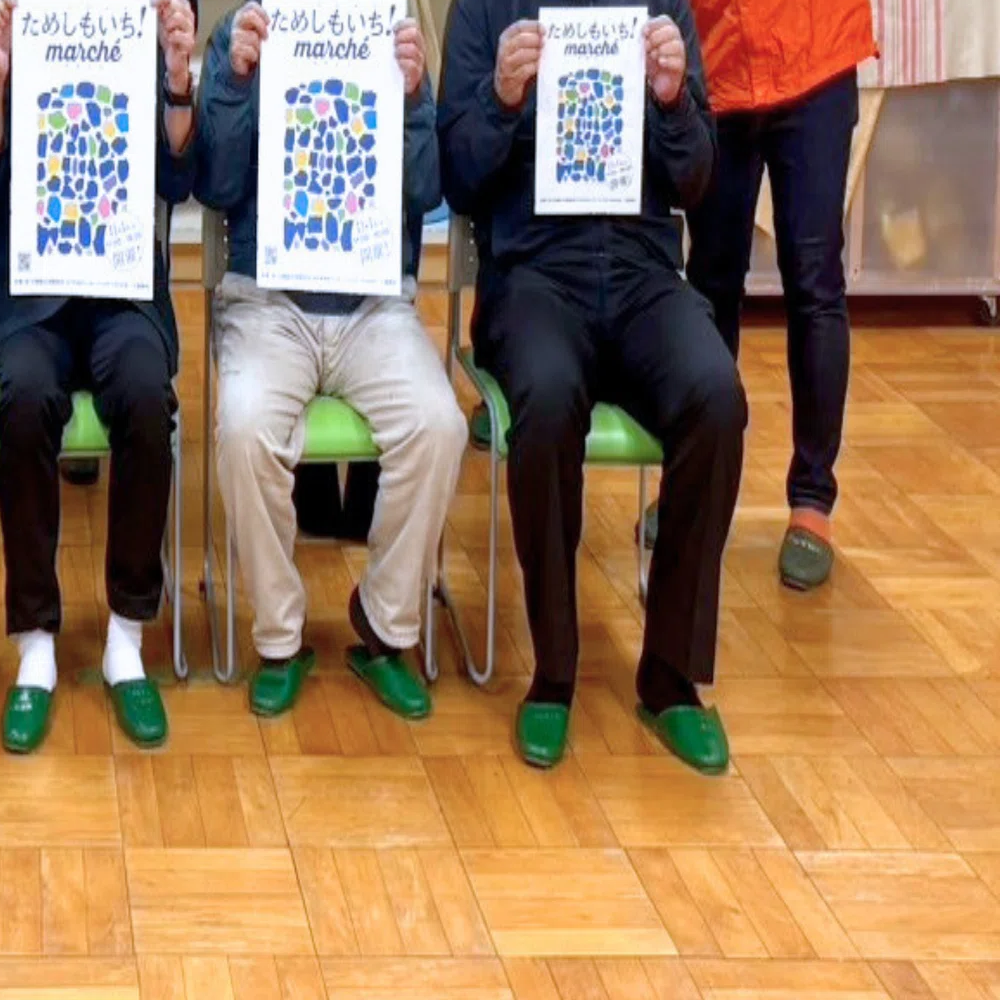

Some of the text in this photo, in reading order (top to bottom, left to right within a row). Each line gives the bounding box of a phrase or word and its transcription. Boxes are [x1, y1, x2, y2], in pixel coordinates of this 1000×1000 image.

[21, 6, 146, 39] ためしもいち!
[270, 4, 396, 36] ためしもいち!
[547, 17, 637, 39] ためしもいち!
[45, 39, 122, 62] marché
[293, 37, 370, 60] marché
[564, 39, 619, 56] marché
